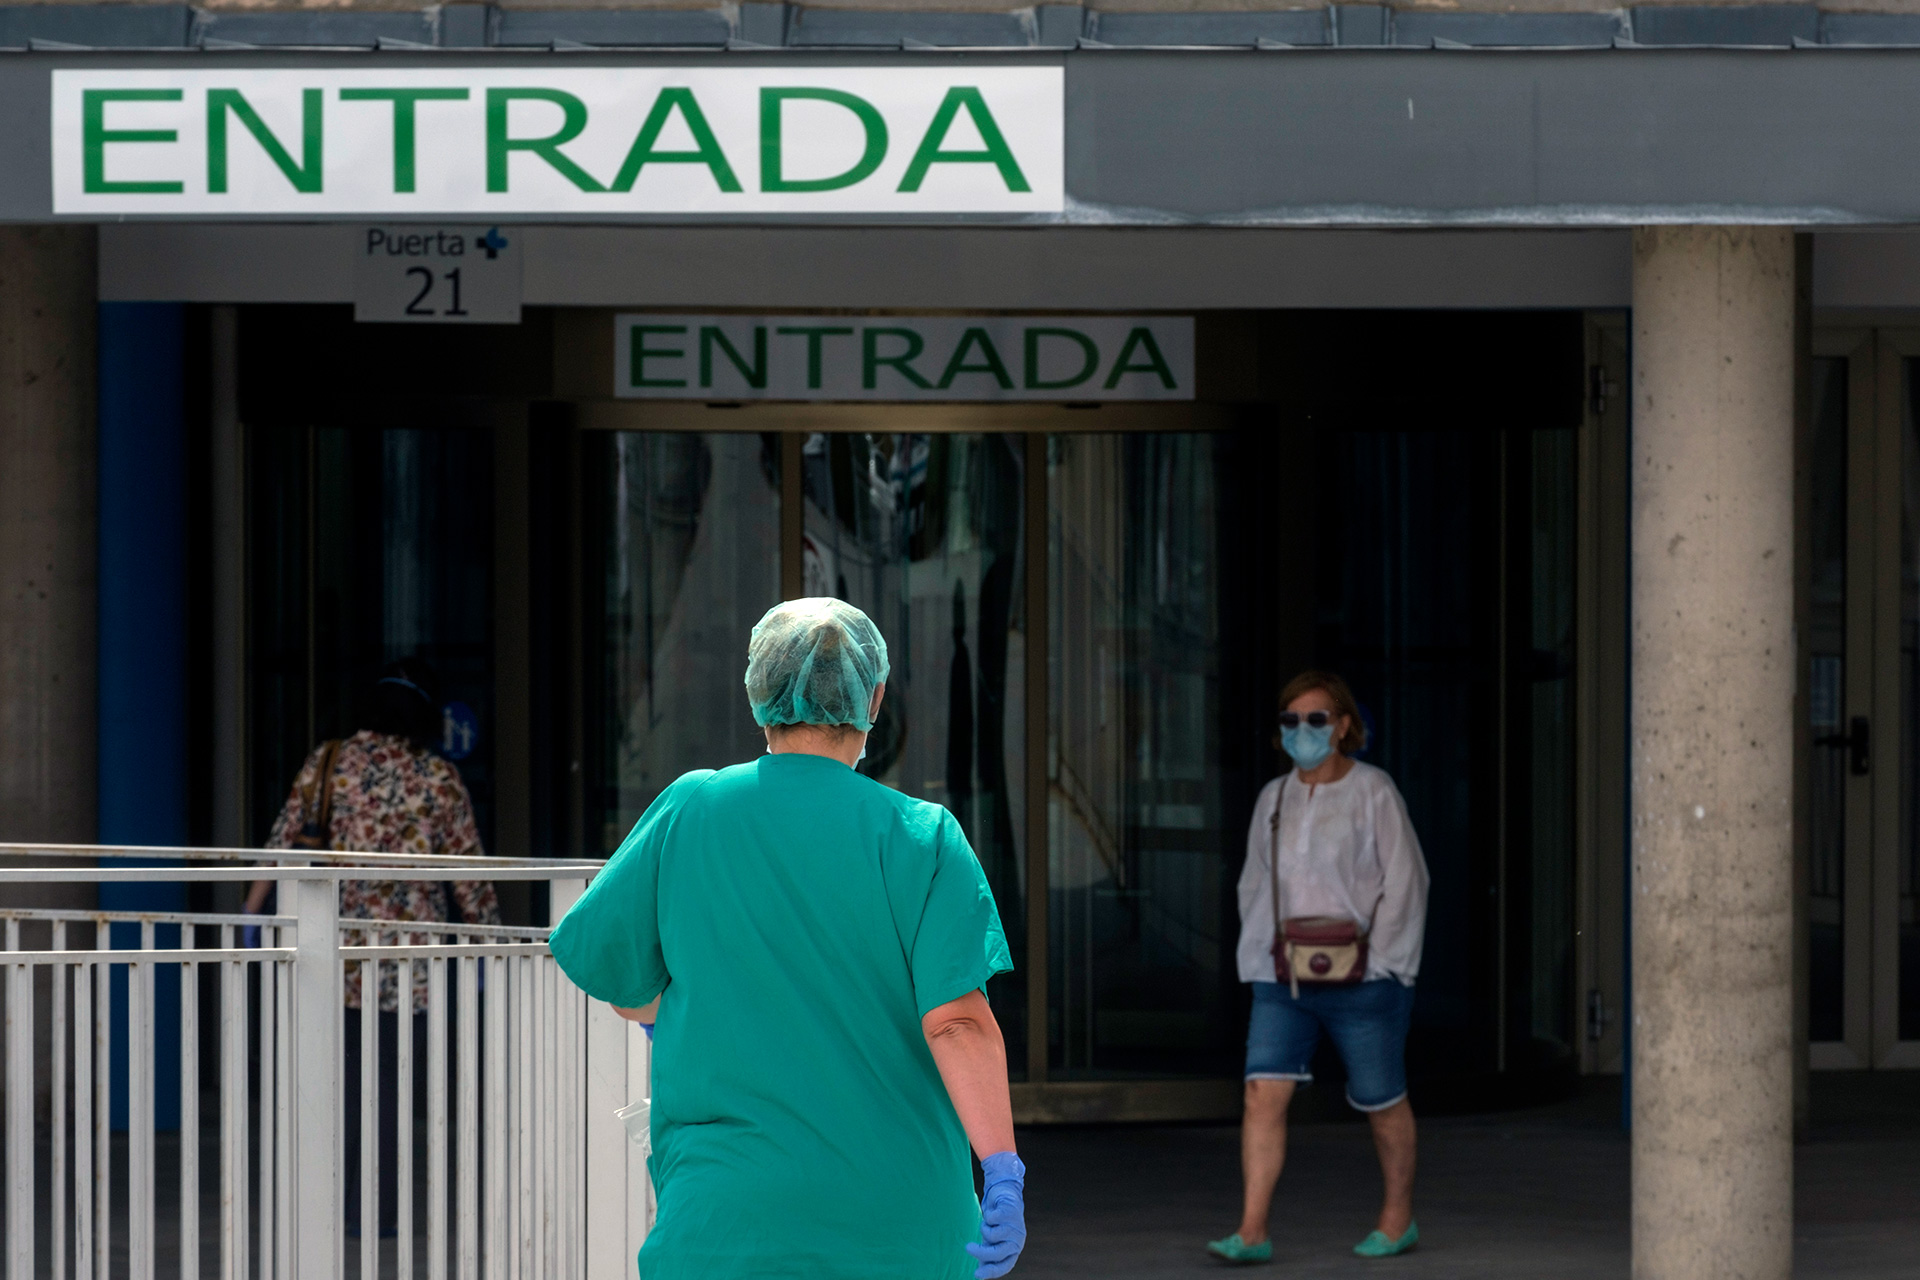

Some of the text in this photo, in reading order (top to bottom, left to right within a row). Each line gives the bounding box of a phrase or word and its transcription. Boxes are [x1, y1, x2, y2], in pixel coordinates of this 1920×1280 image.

[82, 86, 1031, 194] ENTRADA
[367, 228, 465, 256] Puerta
[405, 265, 468, 316] 21
[629, 324, 1178, 390] ENTRADA
